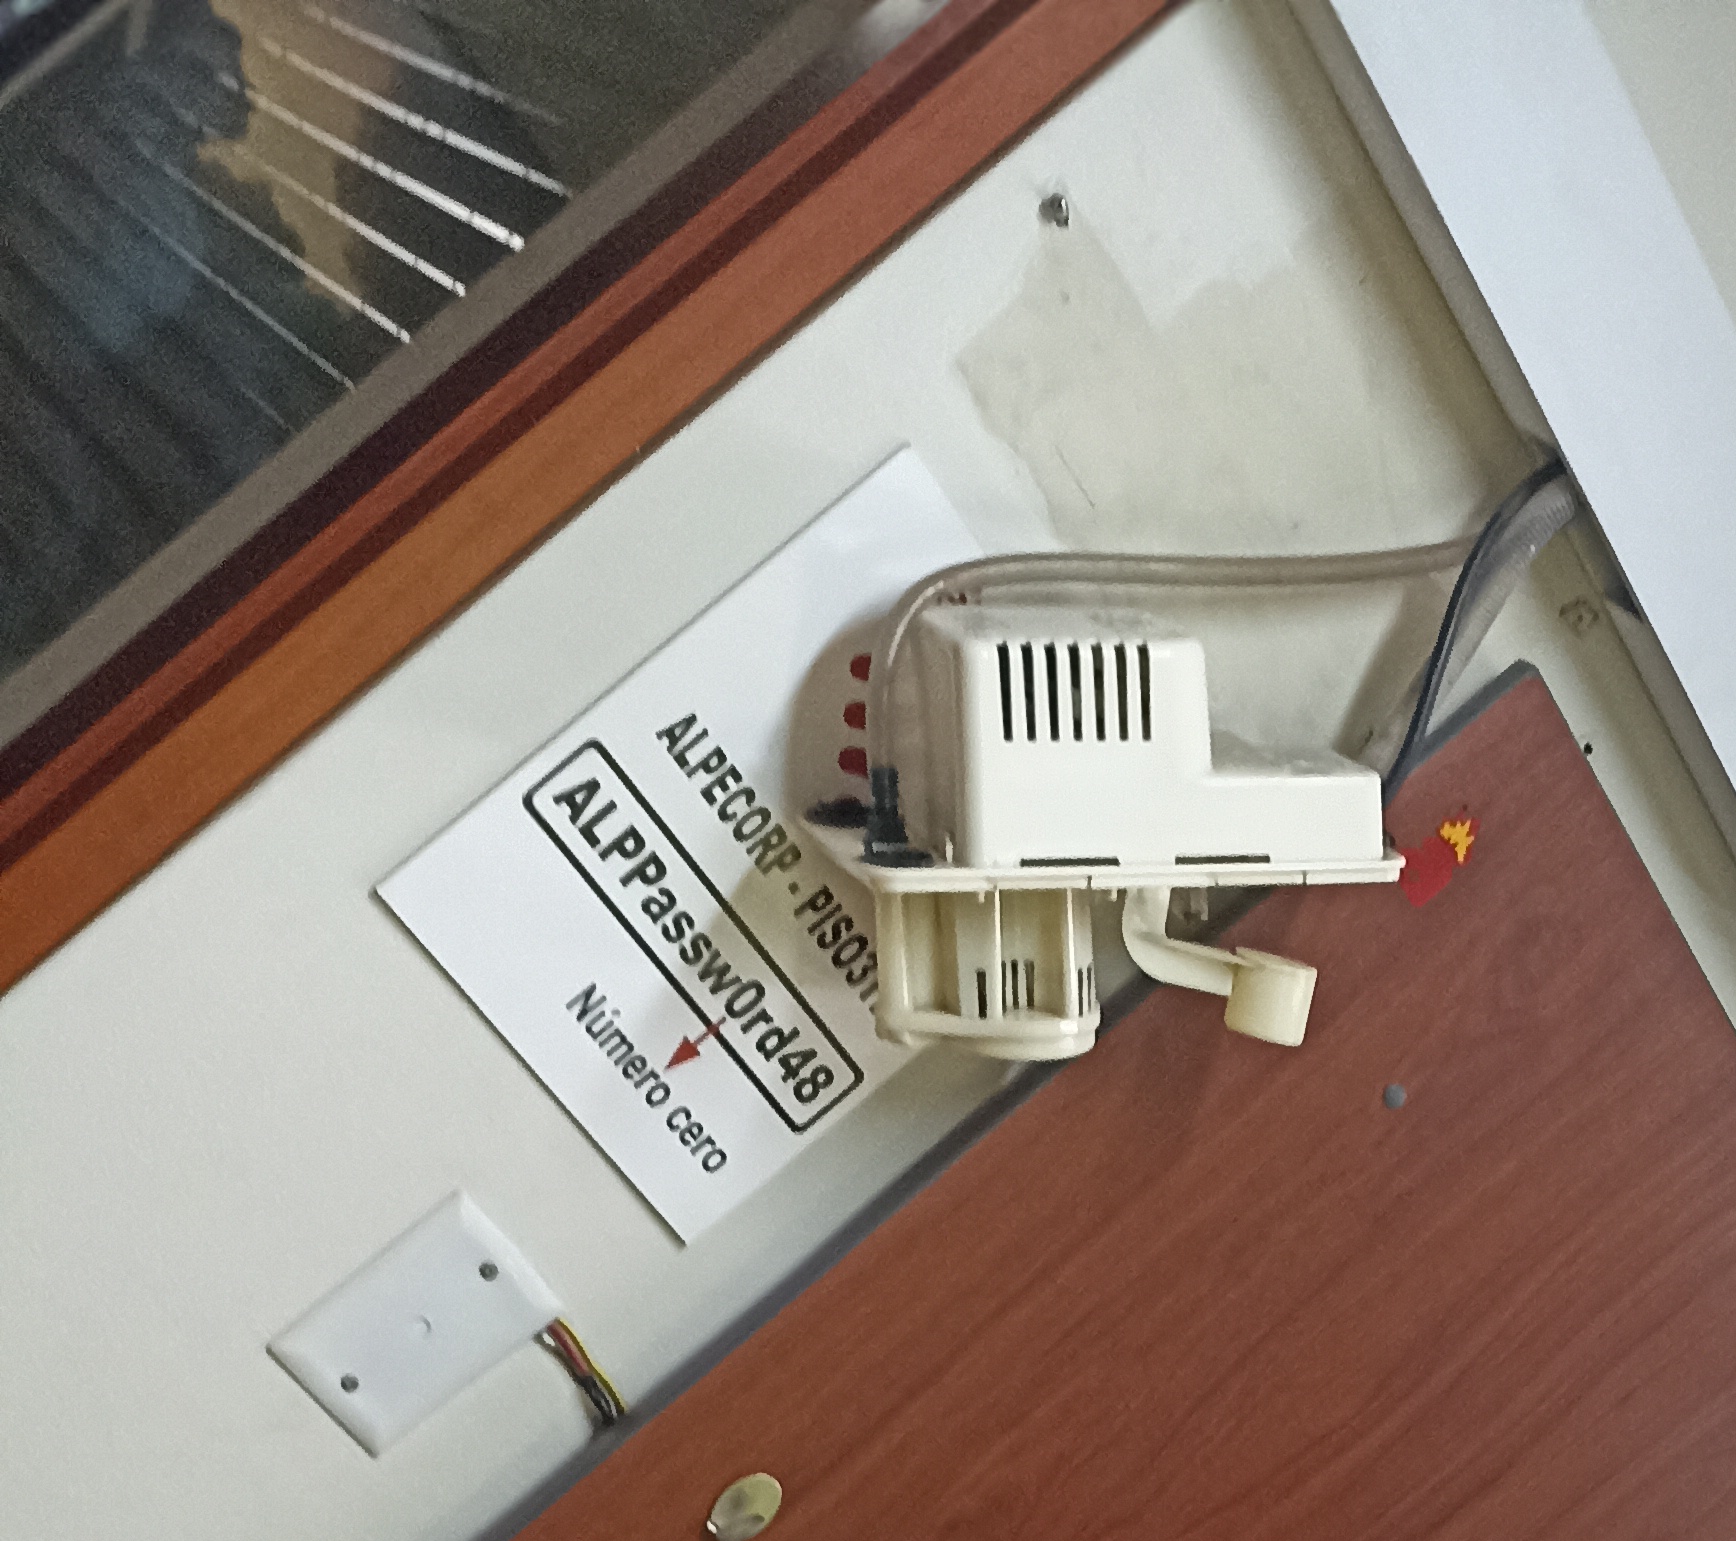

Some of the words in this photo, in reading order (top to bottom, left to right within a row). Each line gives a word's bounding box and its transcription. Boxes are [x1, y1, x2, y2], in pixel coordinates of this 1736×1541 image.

[656, 713, 802, 876] ALPECORP
[565, 982, 671, 1108] Número
[666, 1105, 728, 1174] cero
